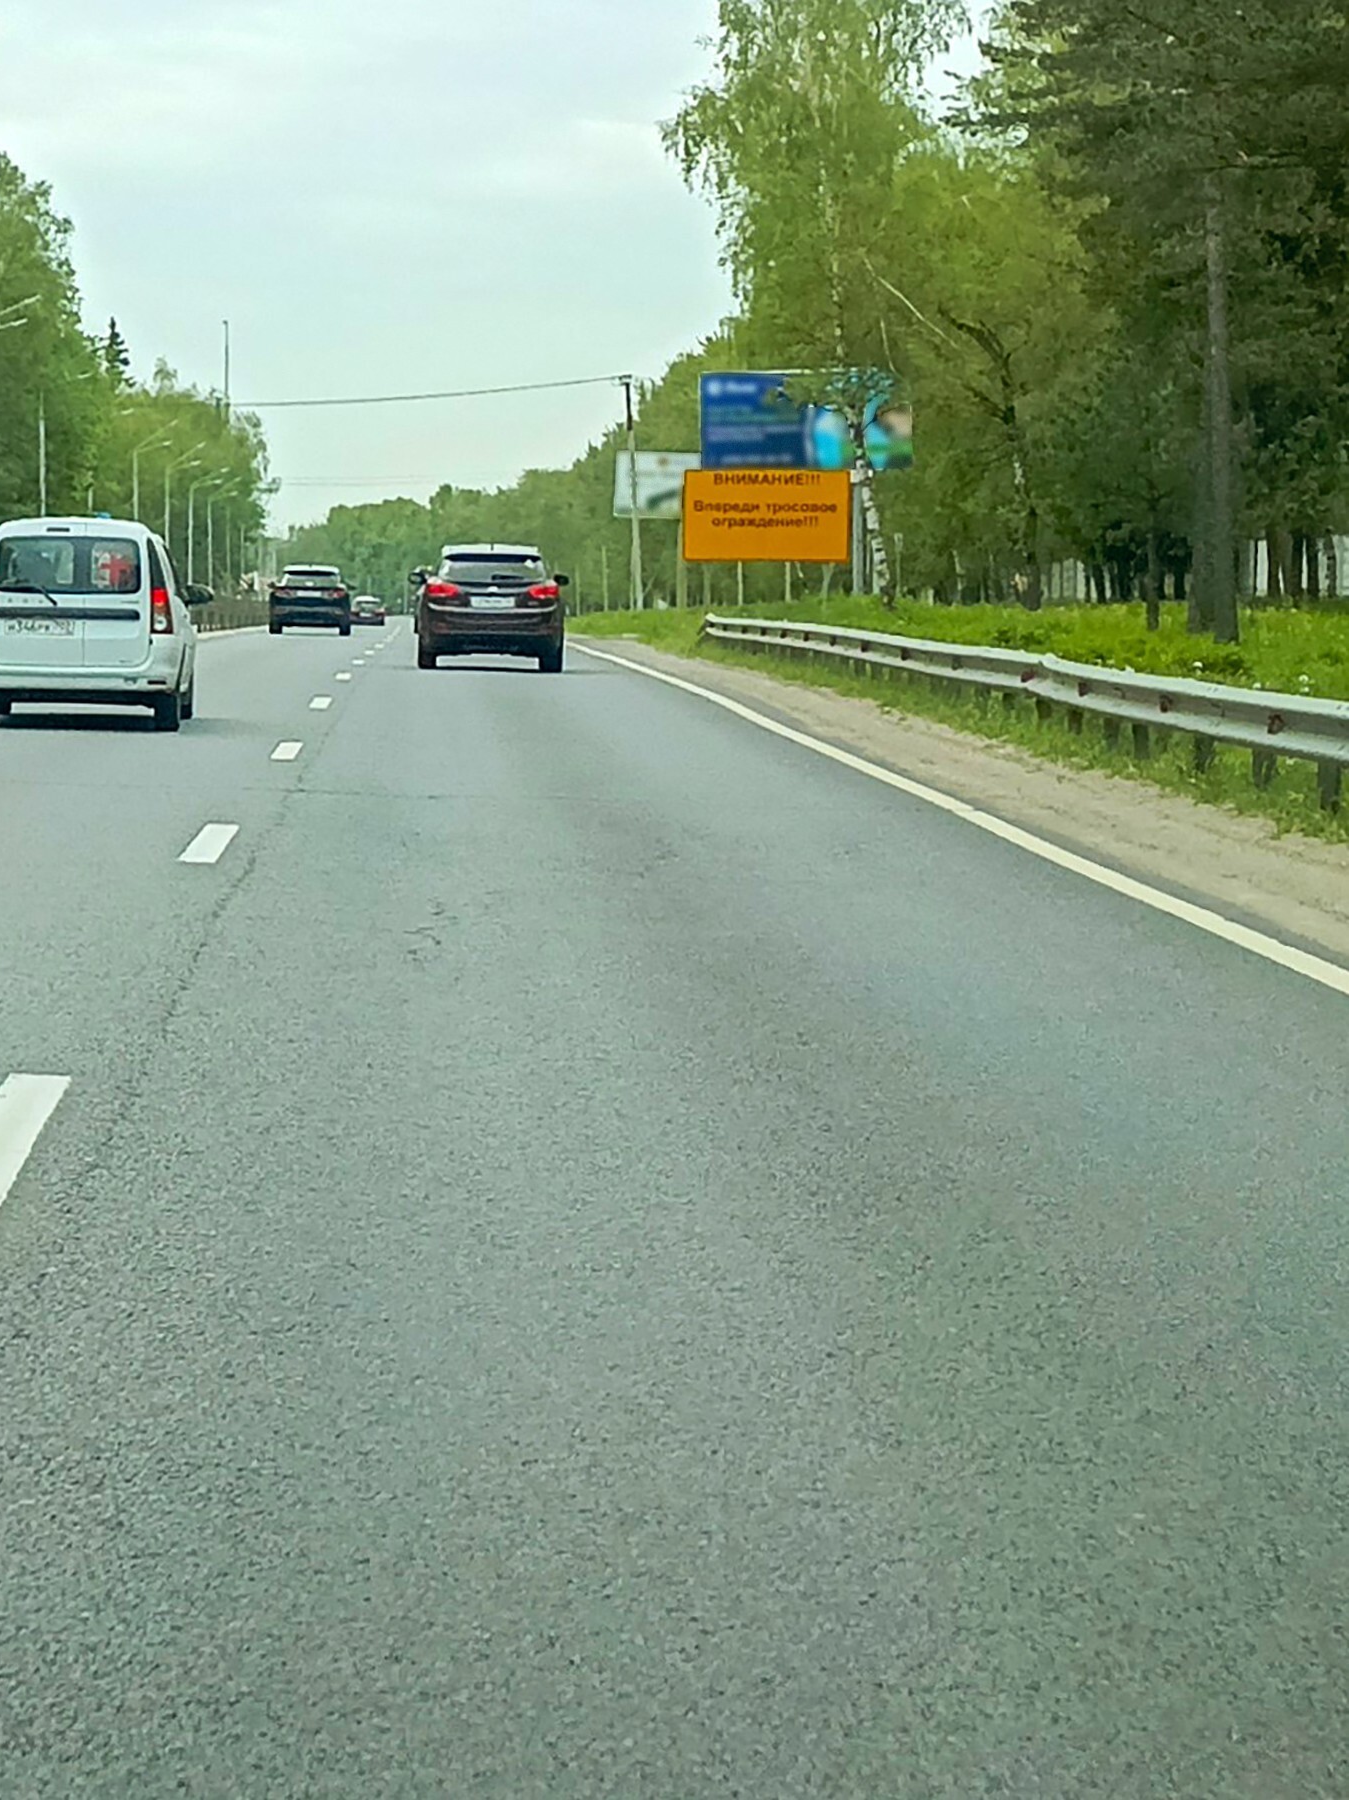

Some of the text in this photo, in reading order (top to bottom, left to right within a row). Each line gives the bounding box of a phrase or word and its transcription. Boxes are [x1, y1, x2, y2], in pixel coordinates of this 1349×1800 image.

[713, 473, 821, 486] ВНИМАНИЕ!!!
[693, 500, 838, 515] Впереди тросовое
[711, 516, 819, 529] ограждение!!!
